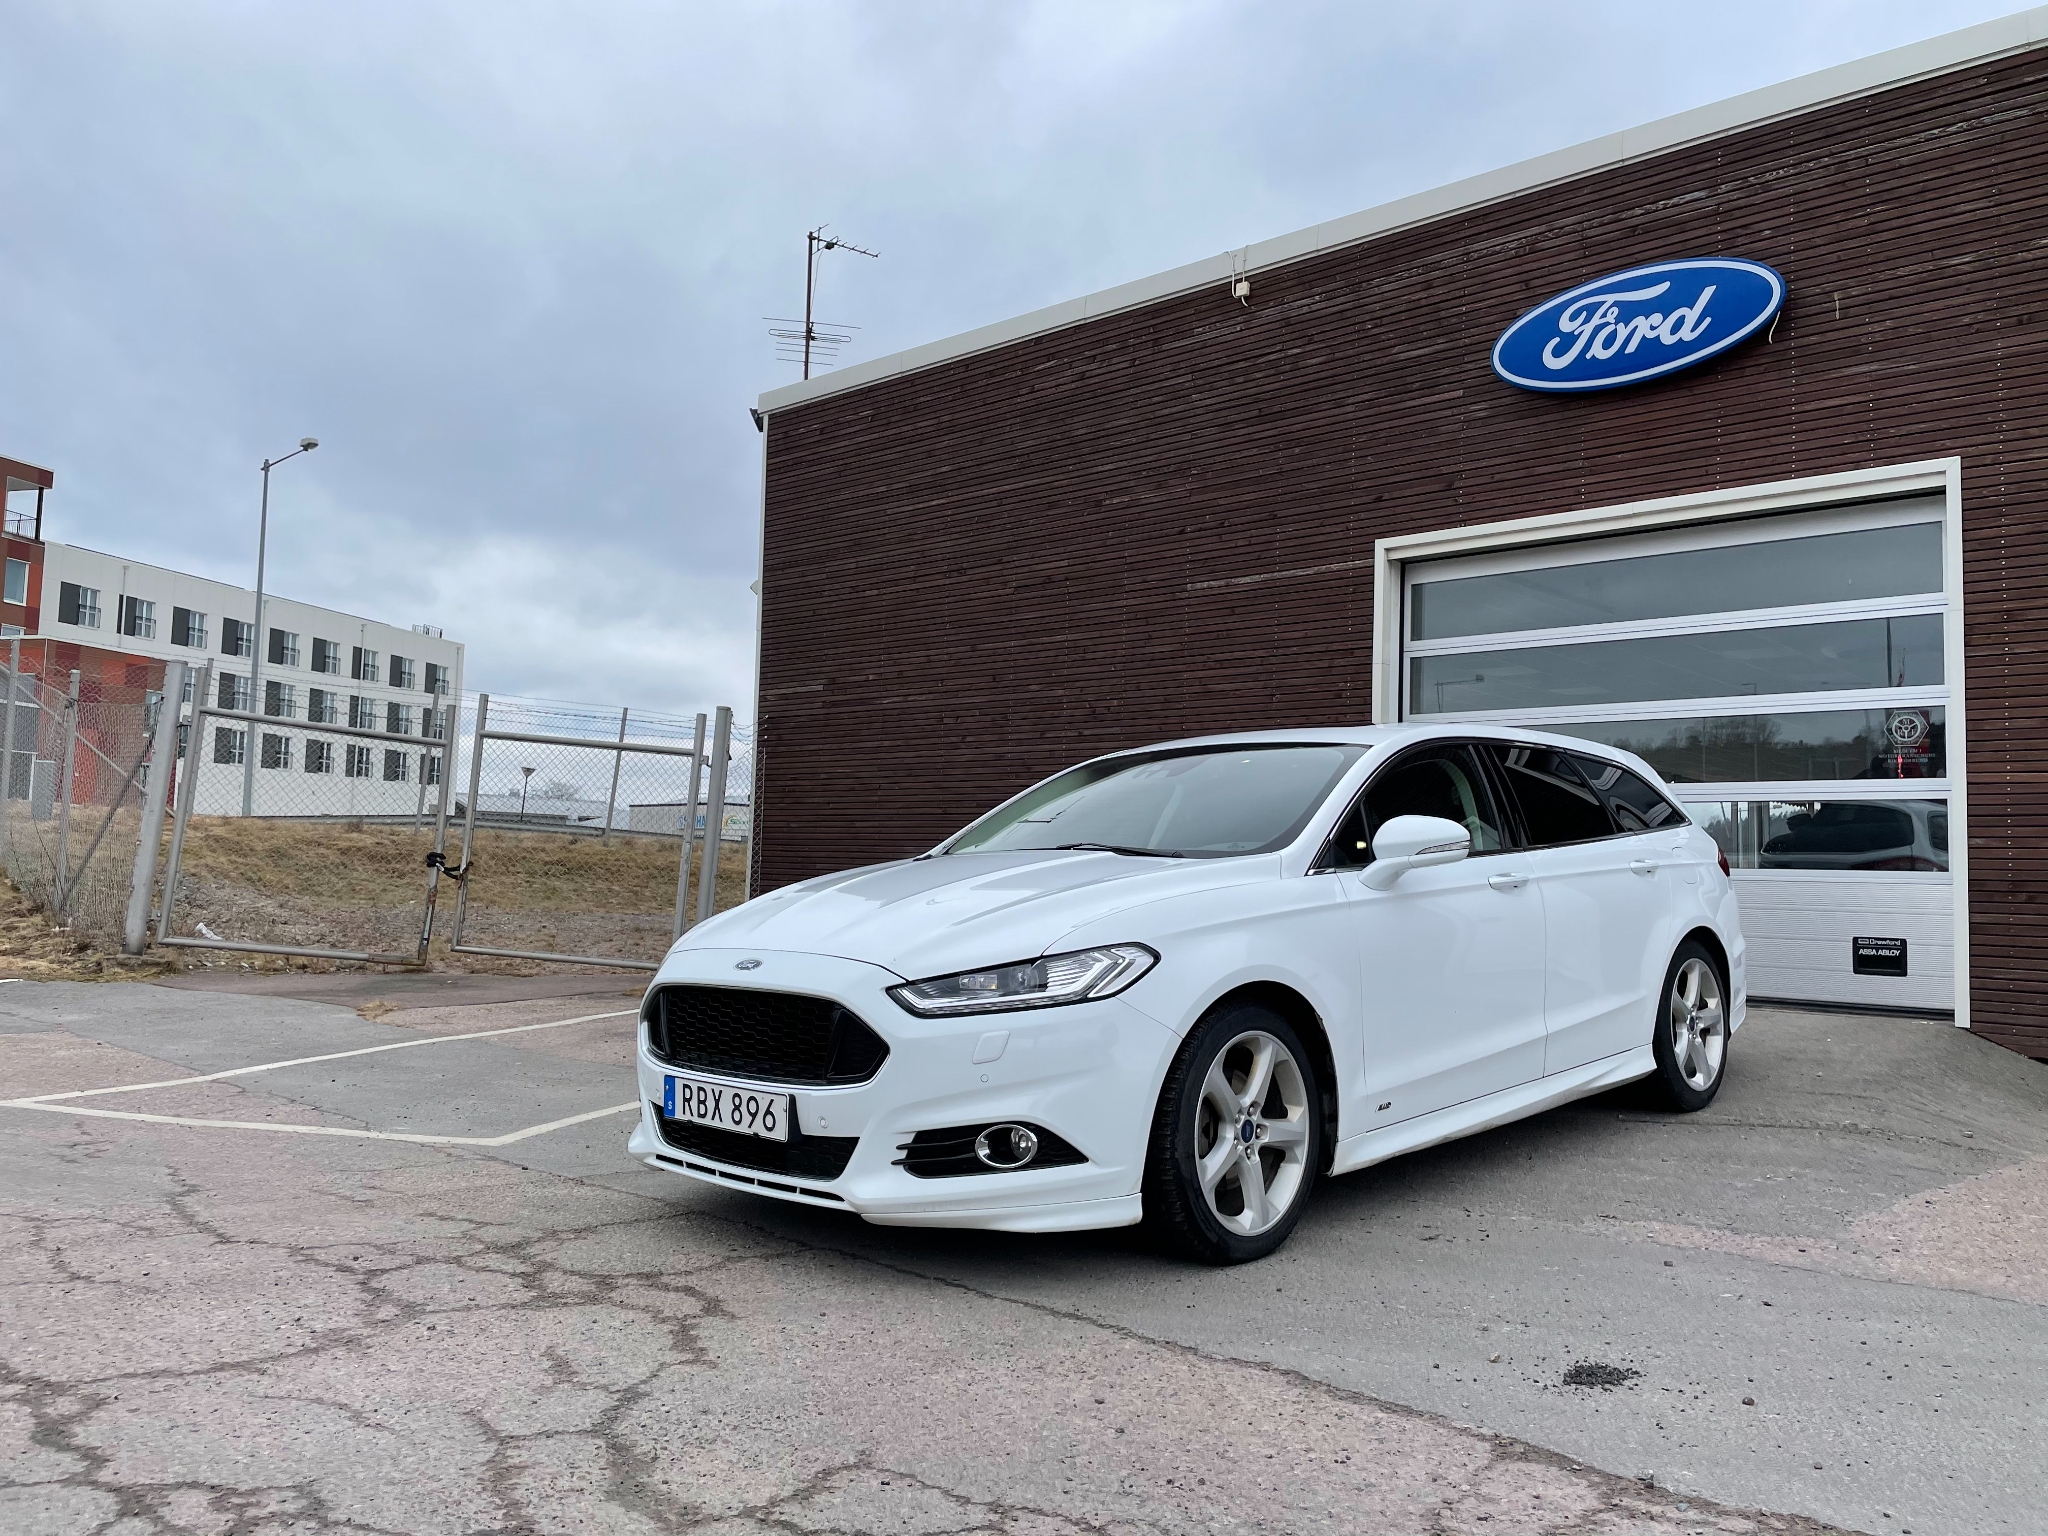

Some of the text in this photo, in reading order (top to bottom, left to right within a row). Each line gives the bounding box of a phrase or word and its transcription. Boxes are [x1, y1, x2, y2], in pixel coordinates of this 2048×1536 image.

[1542, 280, 1717, 370] Ford
[668, 1100, 672, 1110] S
[682, 1083, 777, 1132] RBX 896
